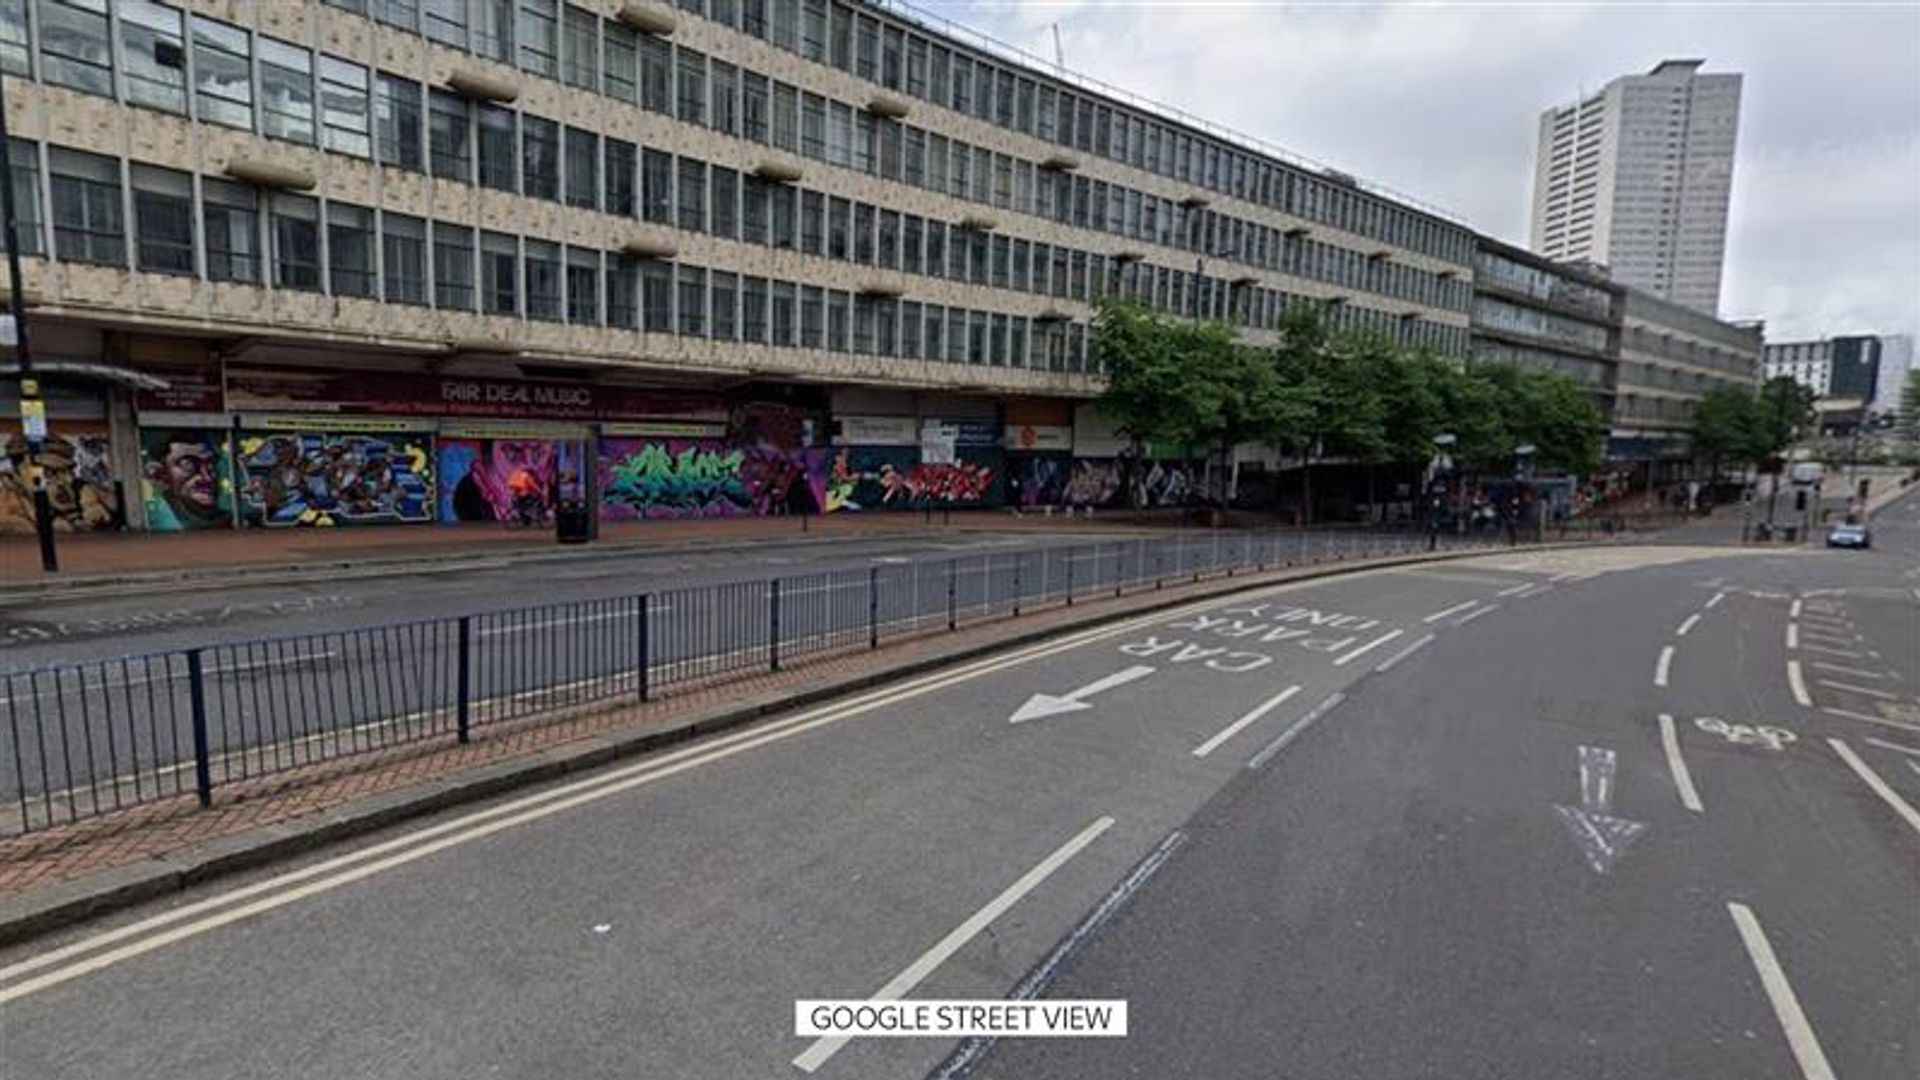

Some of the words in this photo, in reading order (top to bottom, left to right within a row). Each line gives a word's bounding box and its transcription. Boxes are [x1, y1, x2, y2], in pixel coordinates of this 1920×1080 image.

[441, 383, 481, 402] FAIR
[486, 384, 530, 402] DEAL
[534, 387, 592, 406] MUSIC
[1224, 603, 1381, 631] ONLY
[1168, 615, 1356, 652] PARK
[1119, 636, 1273, 673] CAR
